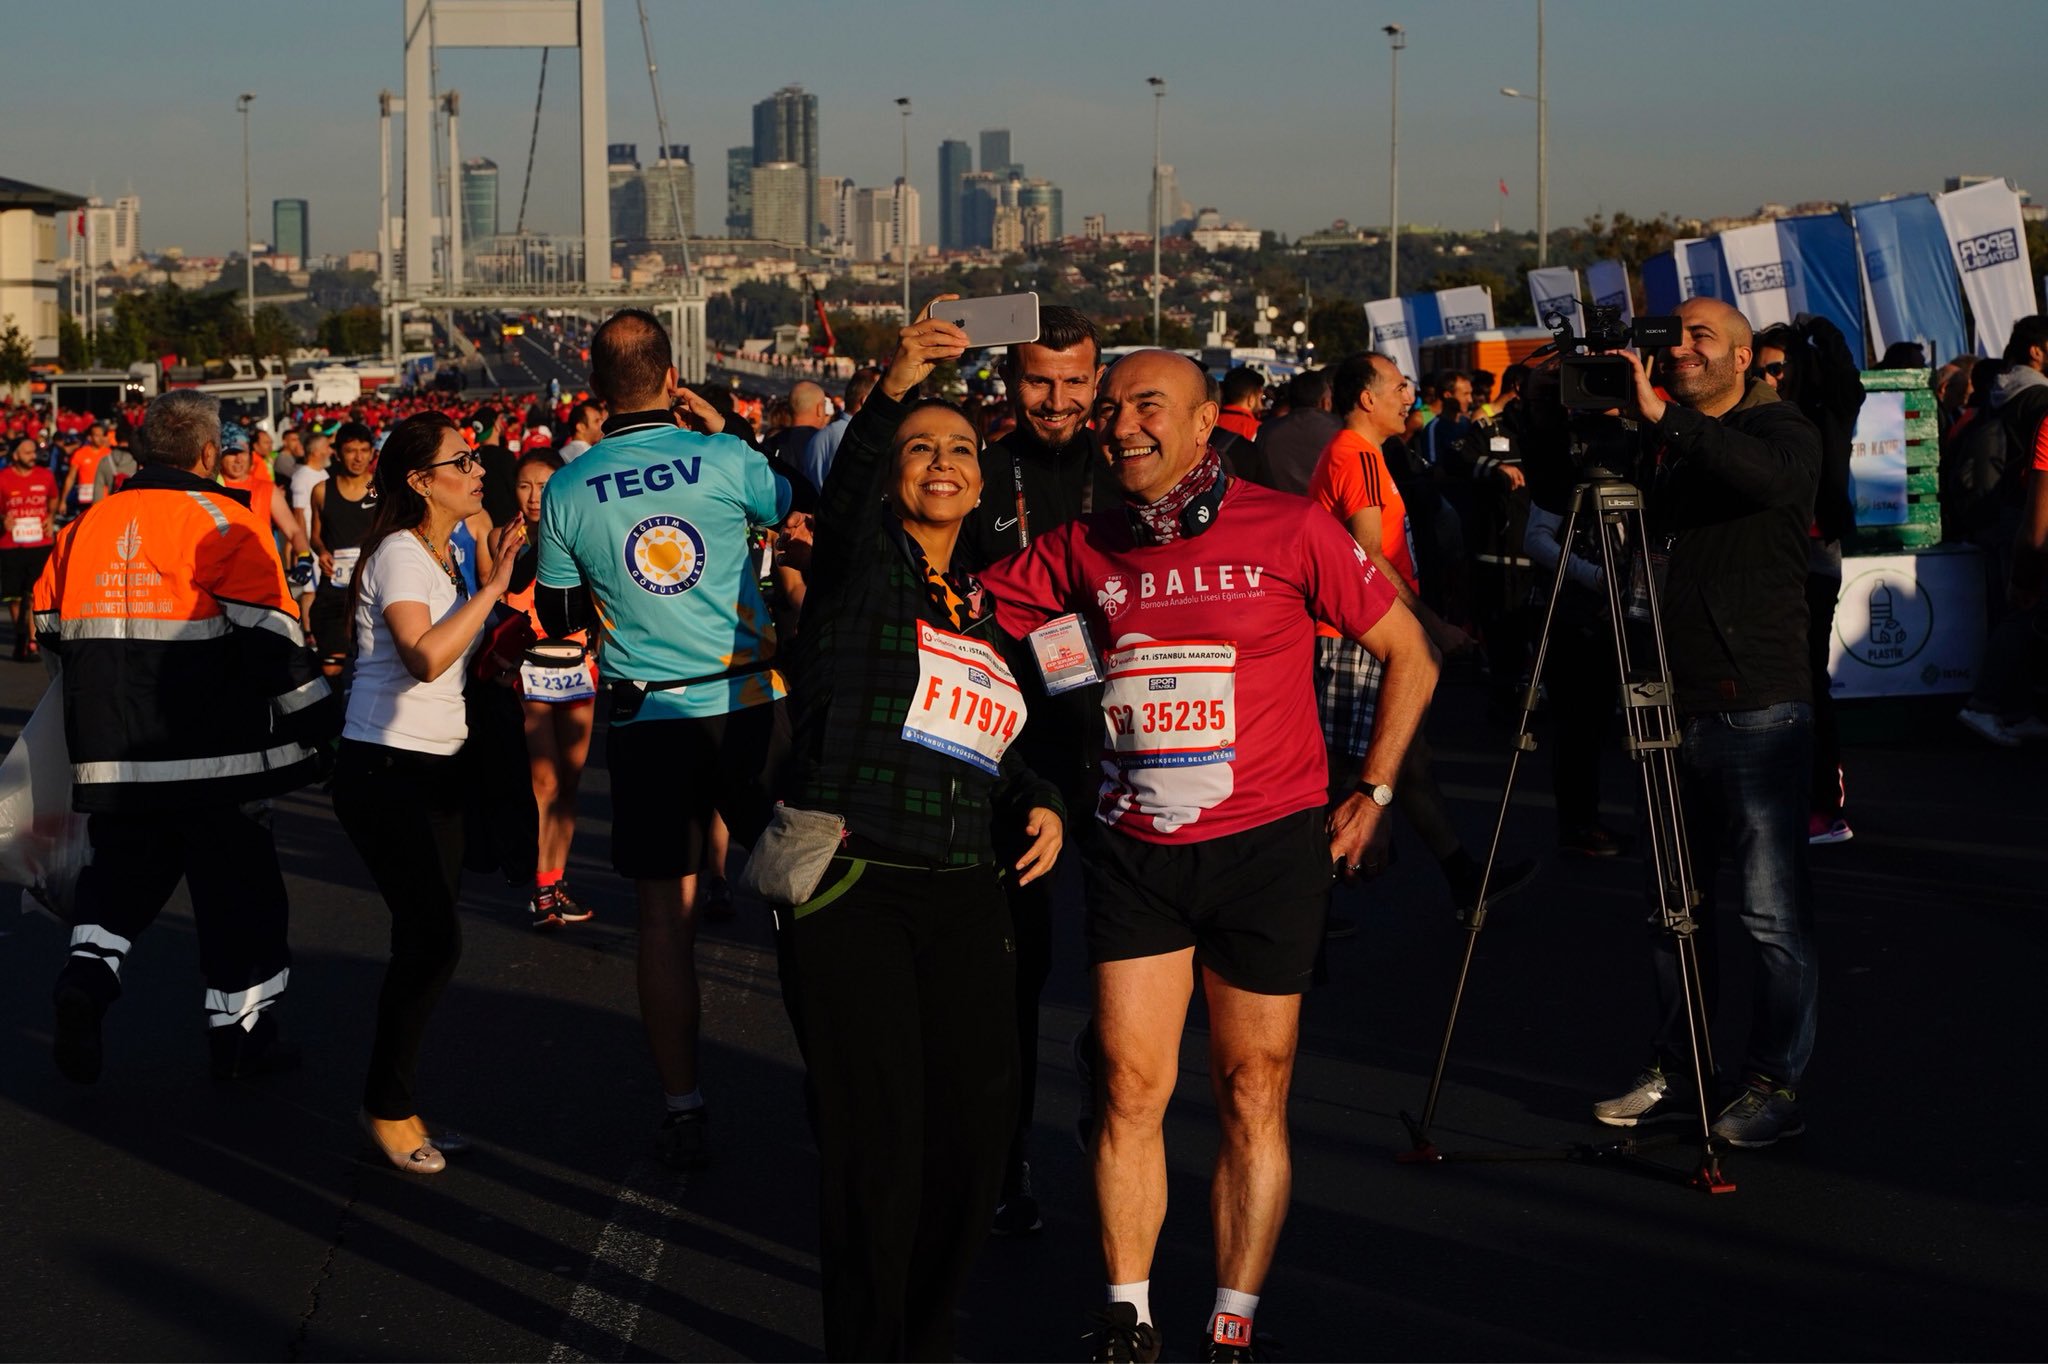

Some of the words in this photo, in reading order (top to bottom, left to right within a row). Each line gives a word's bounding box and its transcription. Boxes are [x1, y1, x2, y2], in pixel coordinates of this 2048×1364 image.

[586, 456, 702, 504] TEGV
[632, 516, 680, 539] EĞİTİM
[1140, 565, 1264, 599] BALEV
[1140, 598, 1169, 610] Bornova
[1169, 596, 1200, 607] Anadolu
[1200, 594, 1221, 603] Lisesi
[1221, 591, 1247, 603] Eğitim
[1140, 653, 1152, 661] 41.
[1152, 652, 1187, 661] İSTANBUL
[1187, 651, 1232, 660] MARATONU
[528, 673, 540, 687] E
[542, 672, 586, 691] 2322
[1150, 678, 1174, 686] SPOR
[923, 675, 943, 711] F
[949, 686, 1018, 744] 17974
[1109, 704, 1135, 735] G2
[1142, 700, 1226, 734] 35235
